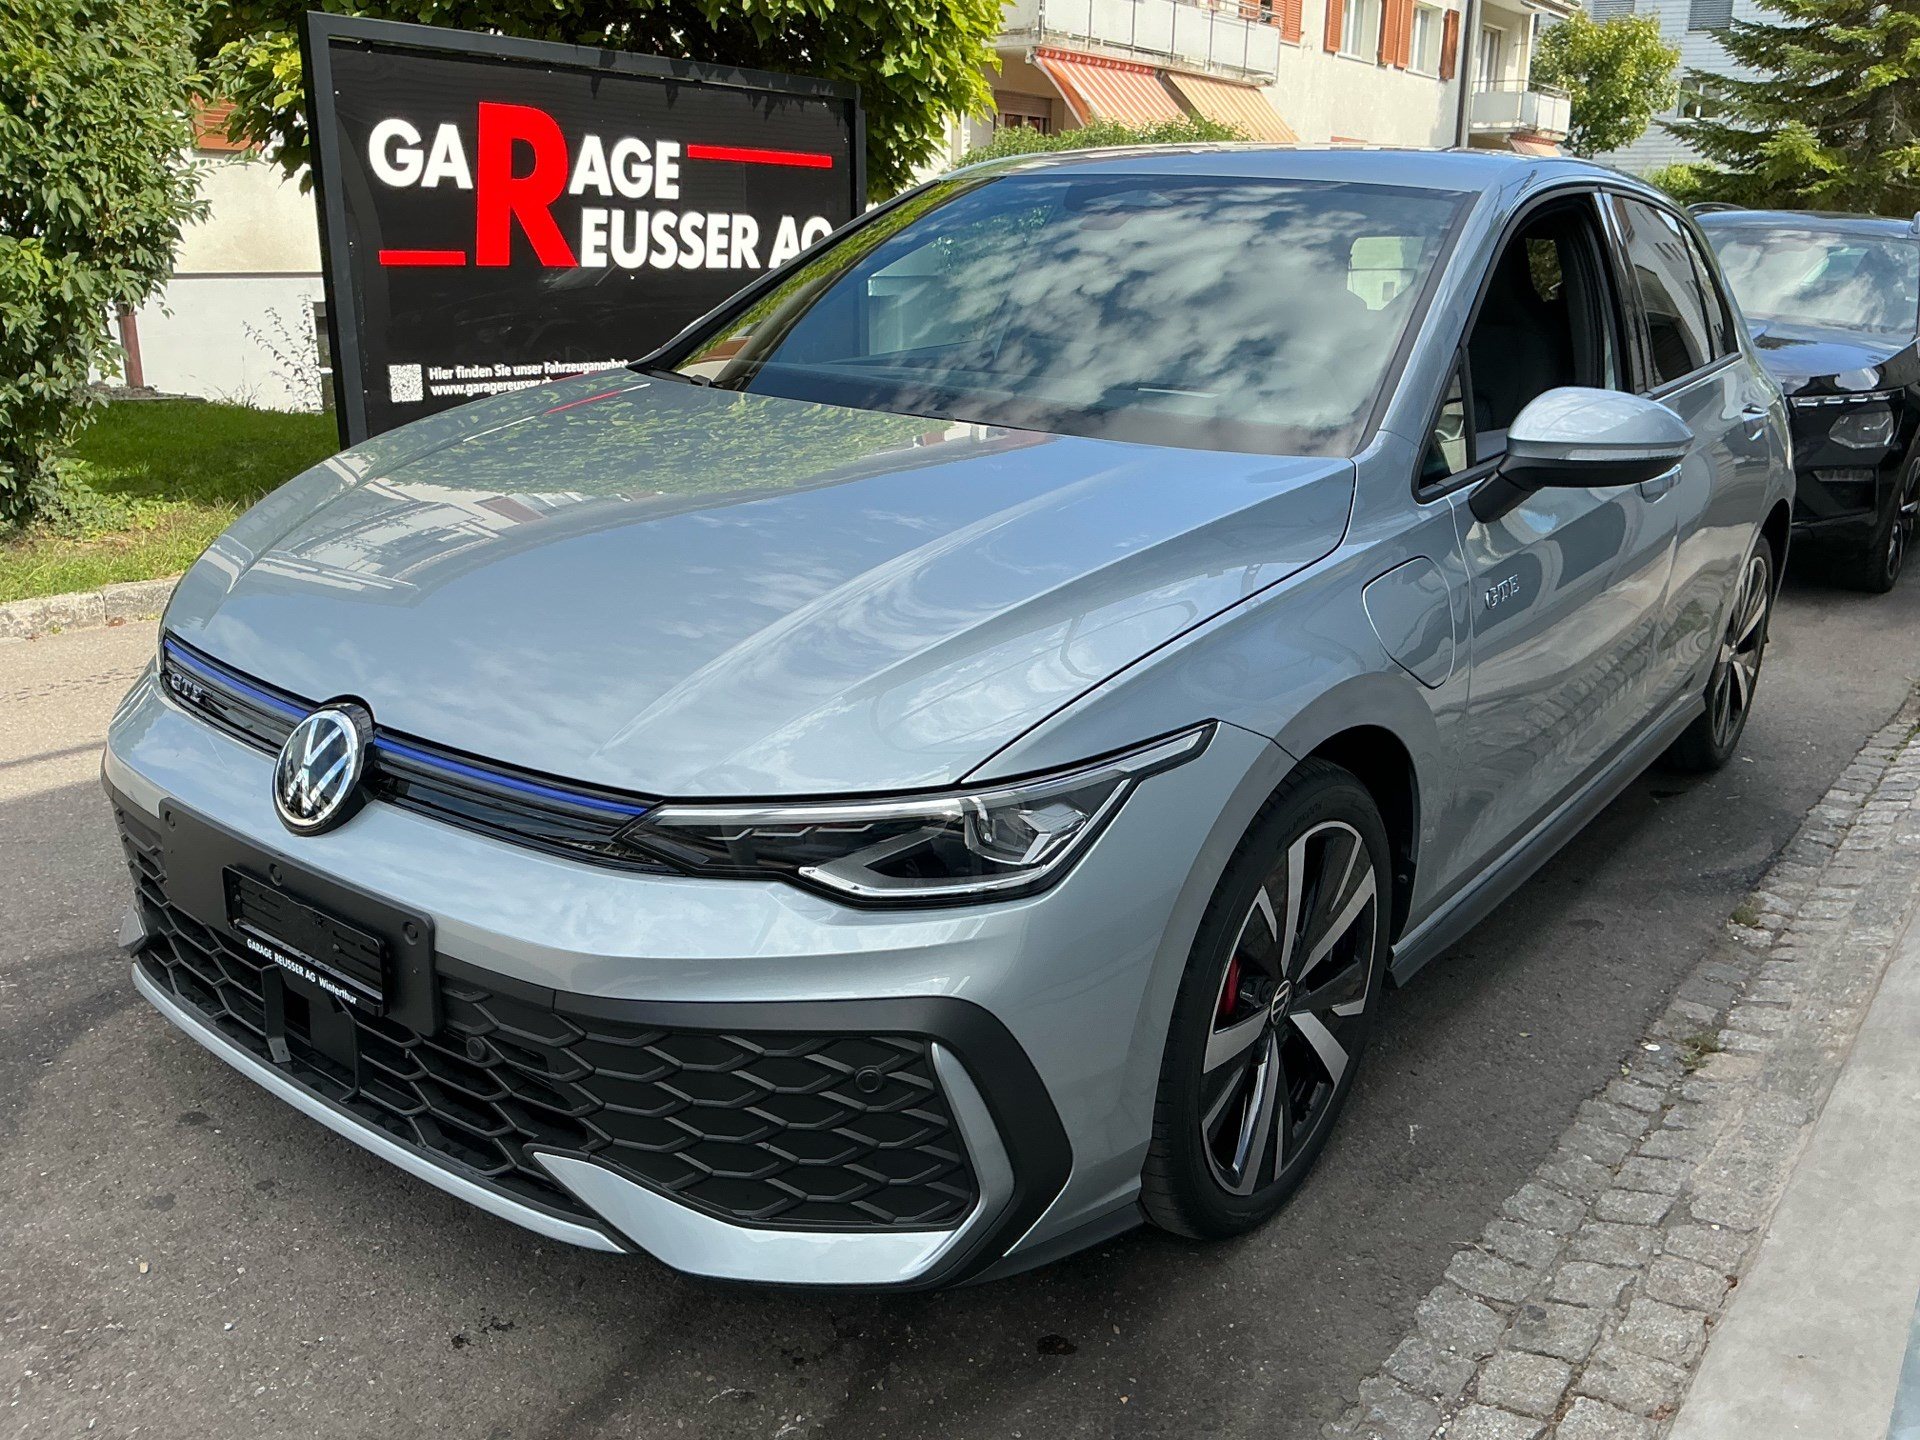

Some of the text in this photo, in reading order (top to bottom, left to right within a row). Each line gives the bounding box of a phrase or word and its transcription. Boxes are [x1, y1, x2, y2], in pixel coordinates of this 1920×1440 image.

[368, 101, 680, 268] GARAGE
[429, 367, 454, 380] Hier
[456, 364, 493, 379] finden
[494, 363, 512, 377] Sie
[513, 364, 543, 375] unser
[1485, 574, 1520, 609] GTE
[171, 672, 203, 703] GTE
[246, 938, 357, 1004] GARAGE REUSSER AG Winterthur
